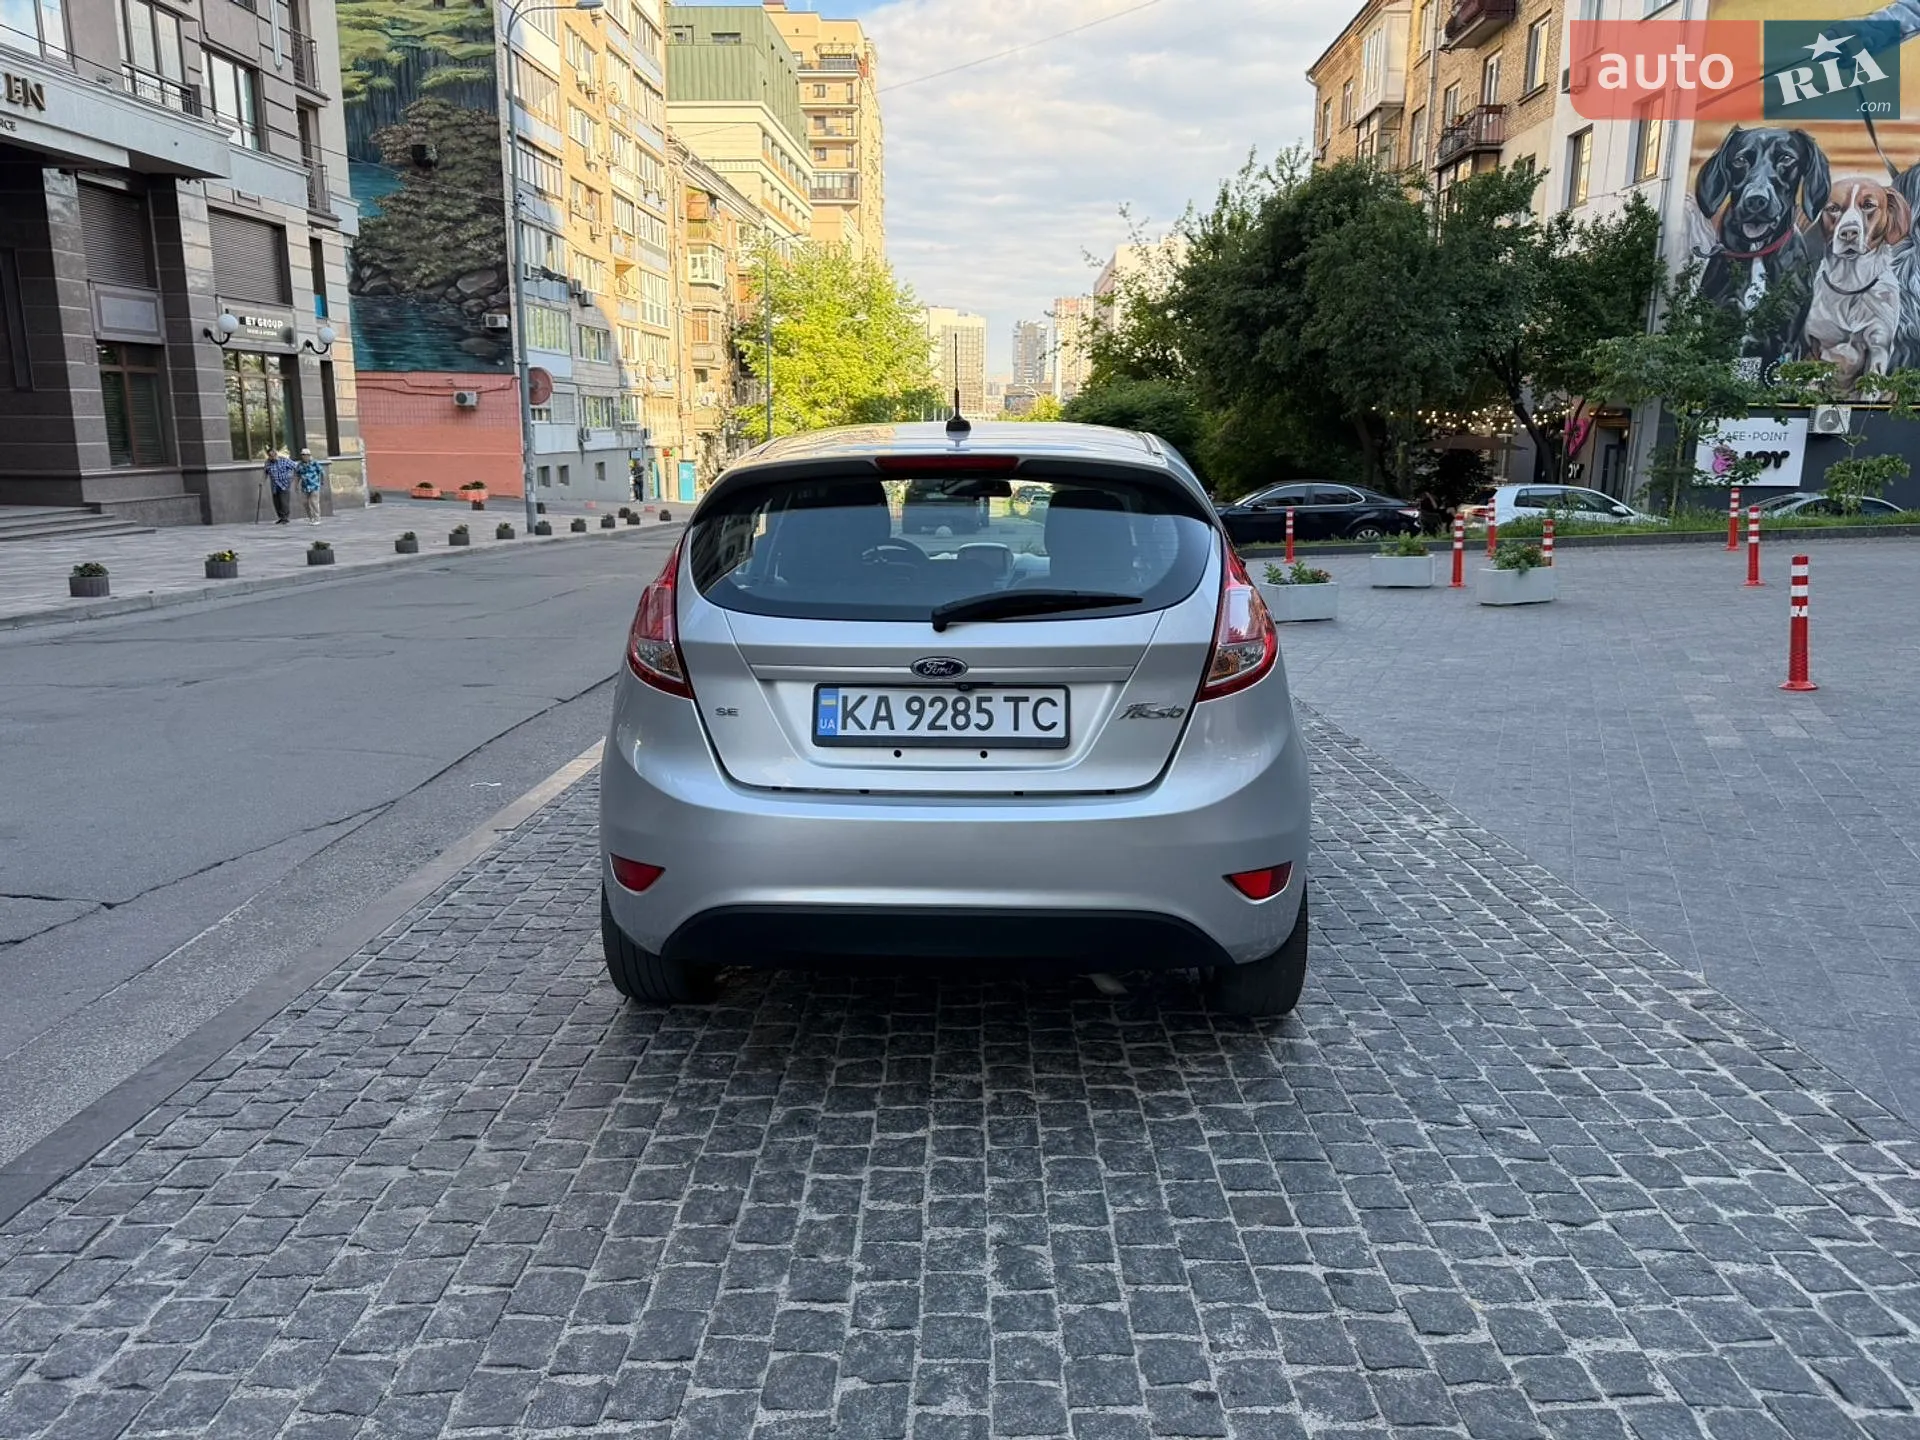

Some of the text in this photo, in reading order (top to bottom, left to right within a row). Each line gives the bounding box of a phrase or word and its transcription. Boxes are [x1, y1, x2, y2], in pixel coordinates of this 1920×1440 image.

[1752, 431, 1789, 442] POINT
[923, 661, 954, 675] Ford
[715, 707, 739, 717] SE
[841, 695, 1059, 732] KA 9285 TC
[820, 718, 836, 730] UA
